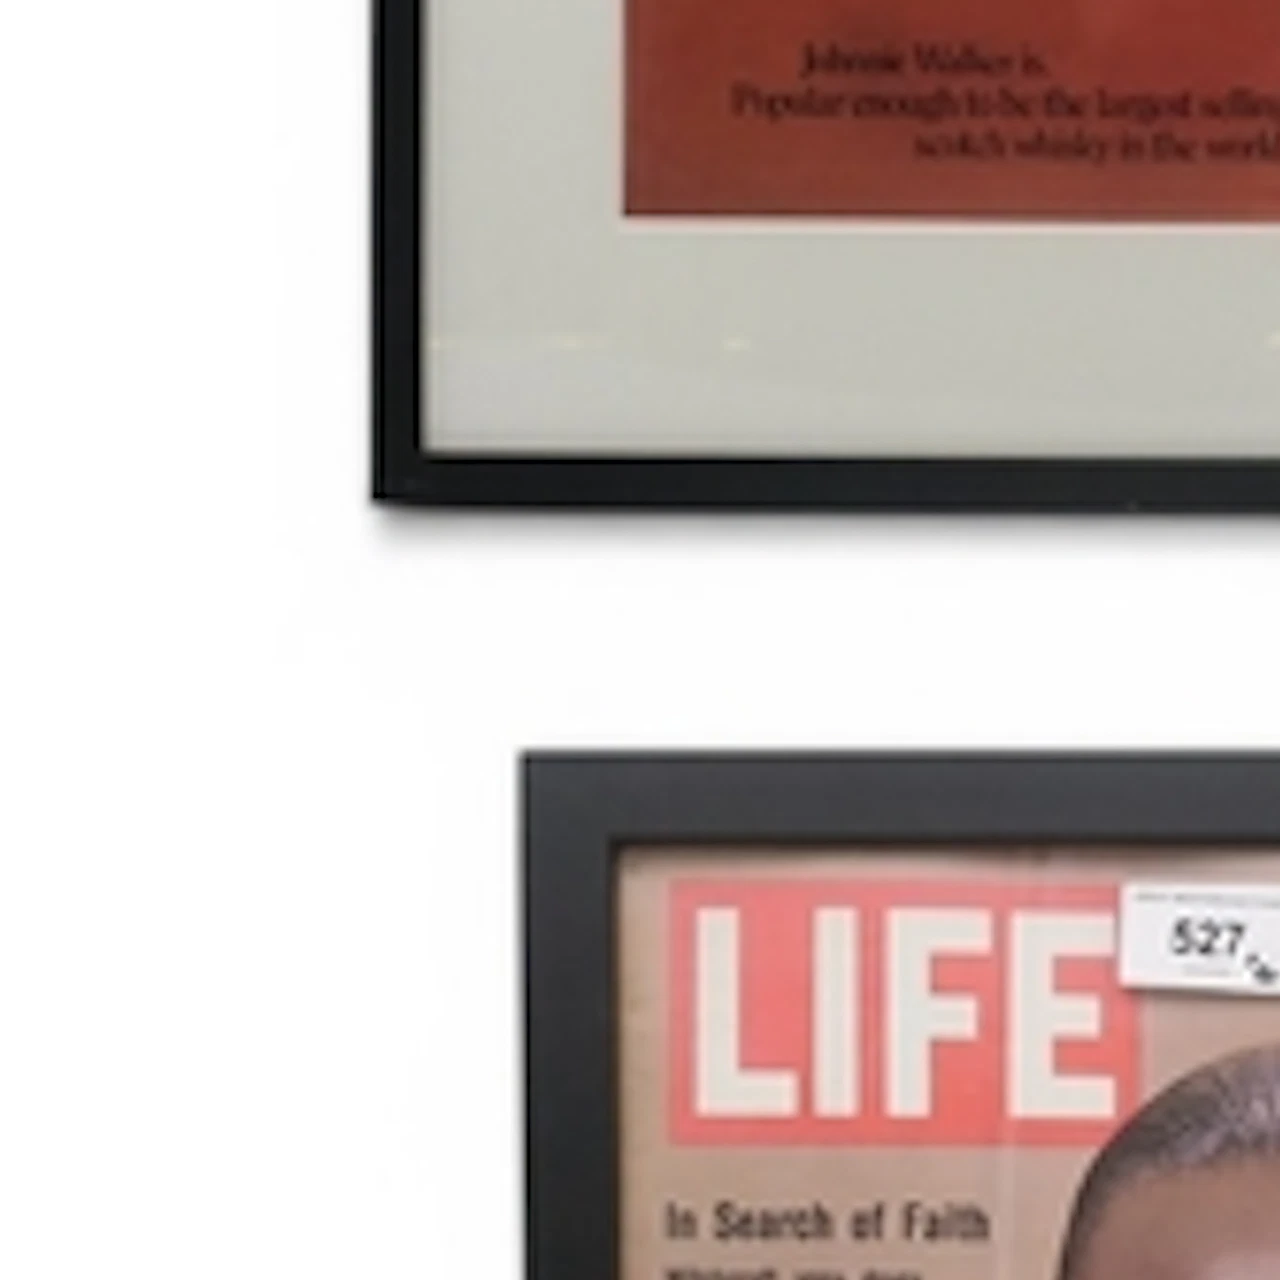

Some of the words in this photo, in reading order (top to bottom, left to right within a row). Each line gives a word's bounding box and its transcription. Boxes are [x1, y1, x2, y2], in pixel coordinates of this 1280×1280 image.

[800, 41, 904, 79] Johnnie
[913, 41, 1014, 75] Walker
[730, 80, 846, 124] Popular
[851, 85, 960, 125] enough
[966, 86, 993, 118] to
[997, 86, 1031, 118] be
[1043, 86, 1085, 118] the
[1097, 86, 1192, 126] largest
[913, 126, 1006, 160] scotch
[1013, 126, 1108, 168] whisky
[1151, 129, 1195, 161] the
[1171, 916, 1247, 957] 527
[692, 904, 1119, 1120] LIFE
[664, 1200, 698, 1241] In
[711, 1200, 835, 1243] Search
[851, 1200, 886, 1241] of
[902, 1200, 990, 1242] Faith
